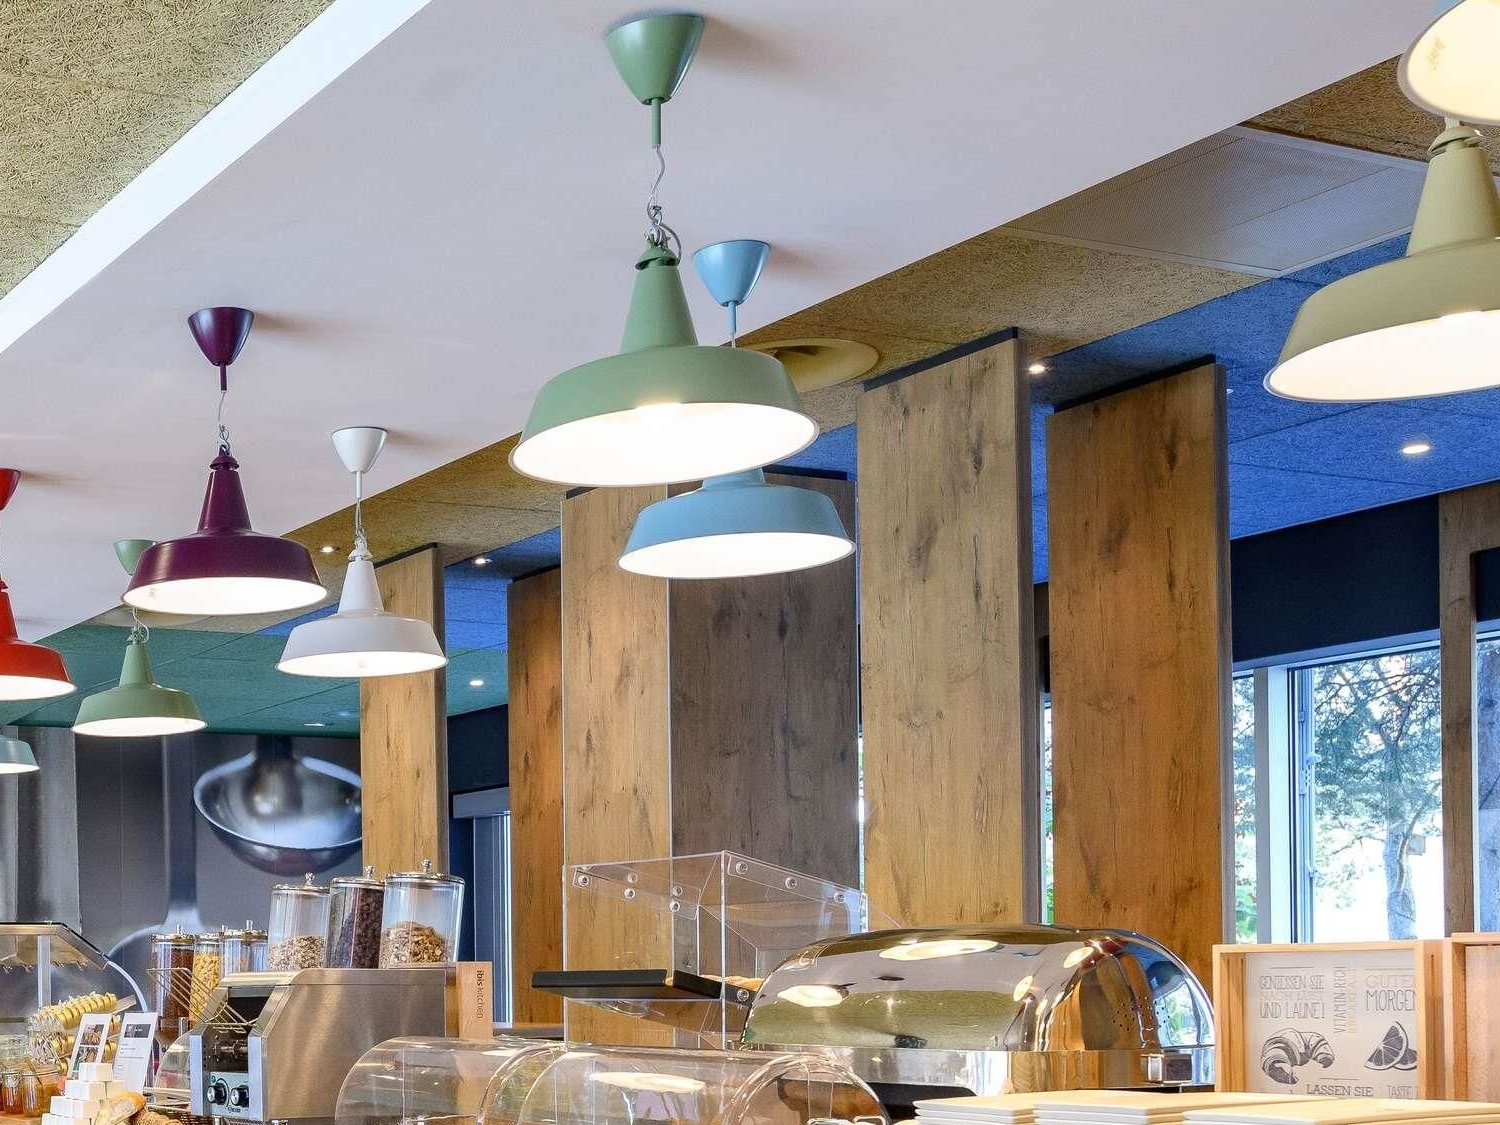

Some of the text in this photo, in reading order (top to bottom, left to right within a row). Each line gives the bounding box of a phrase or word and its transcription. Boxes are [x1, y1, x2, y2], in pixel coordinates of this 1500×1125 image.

[1309, 974, 1325, 990] SIE
[476, 970, 485, 1019] ibis kitchen
[1259, 1002, 1282, 1019] UND
[1306, 1083, 1352, 1096] LASSEN
[1354, 1086, 1374, 1097] SIE
